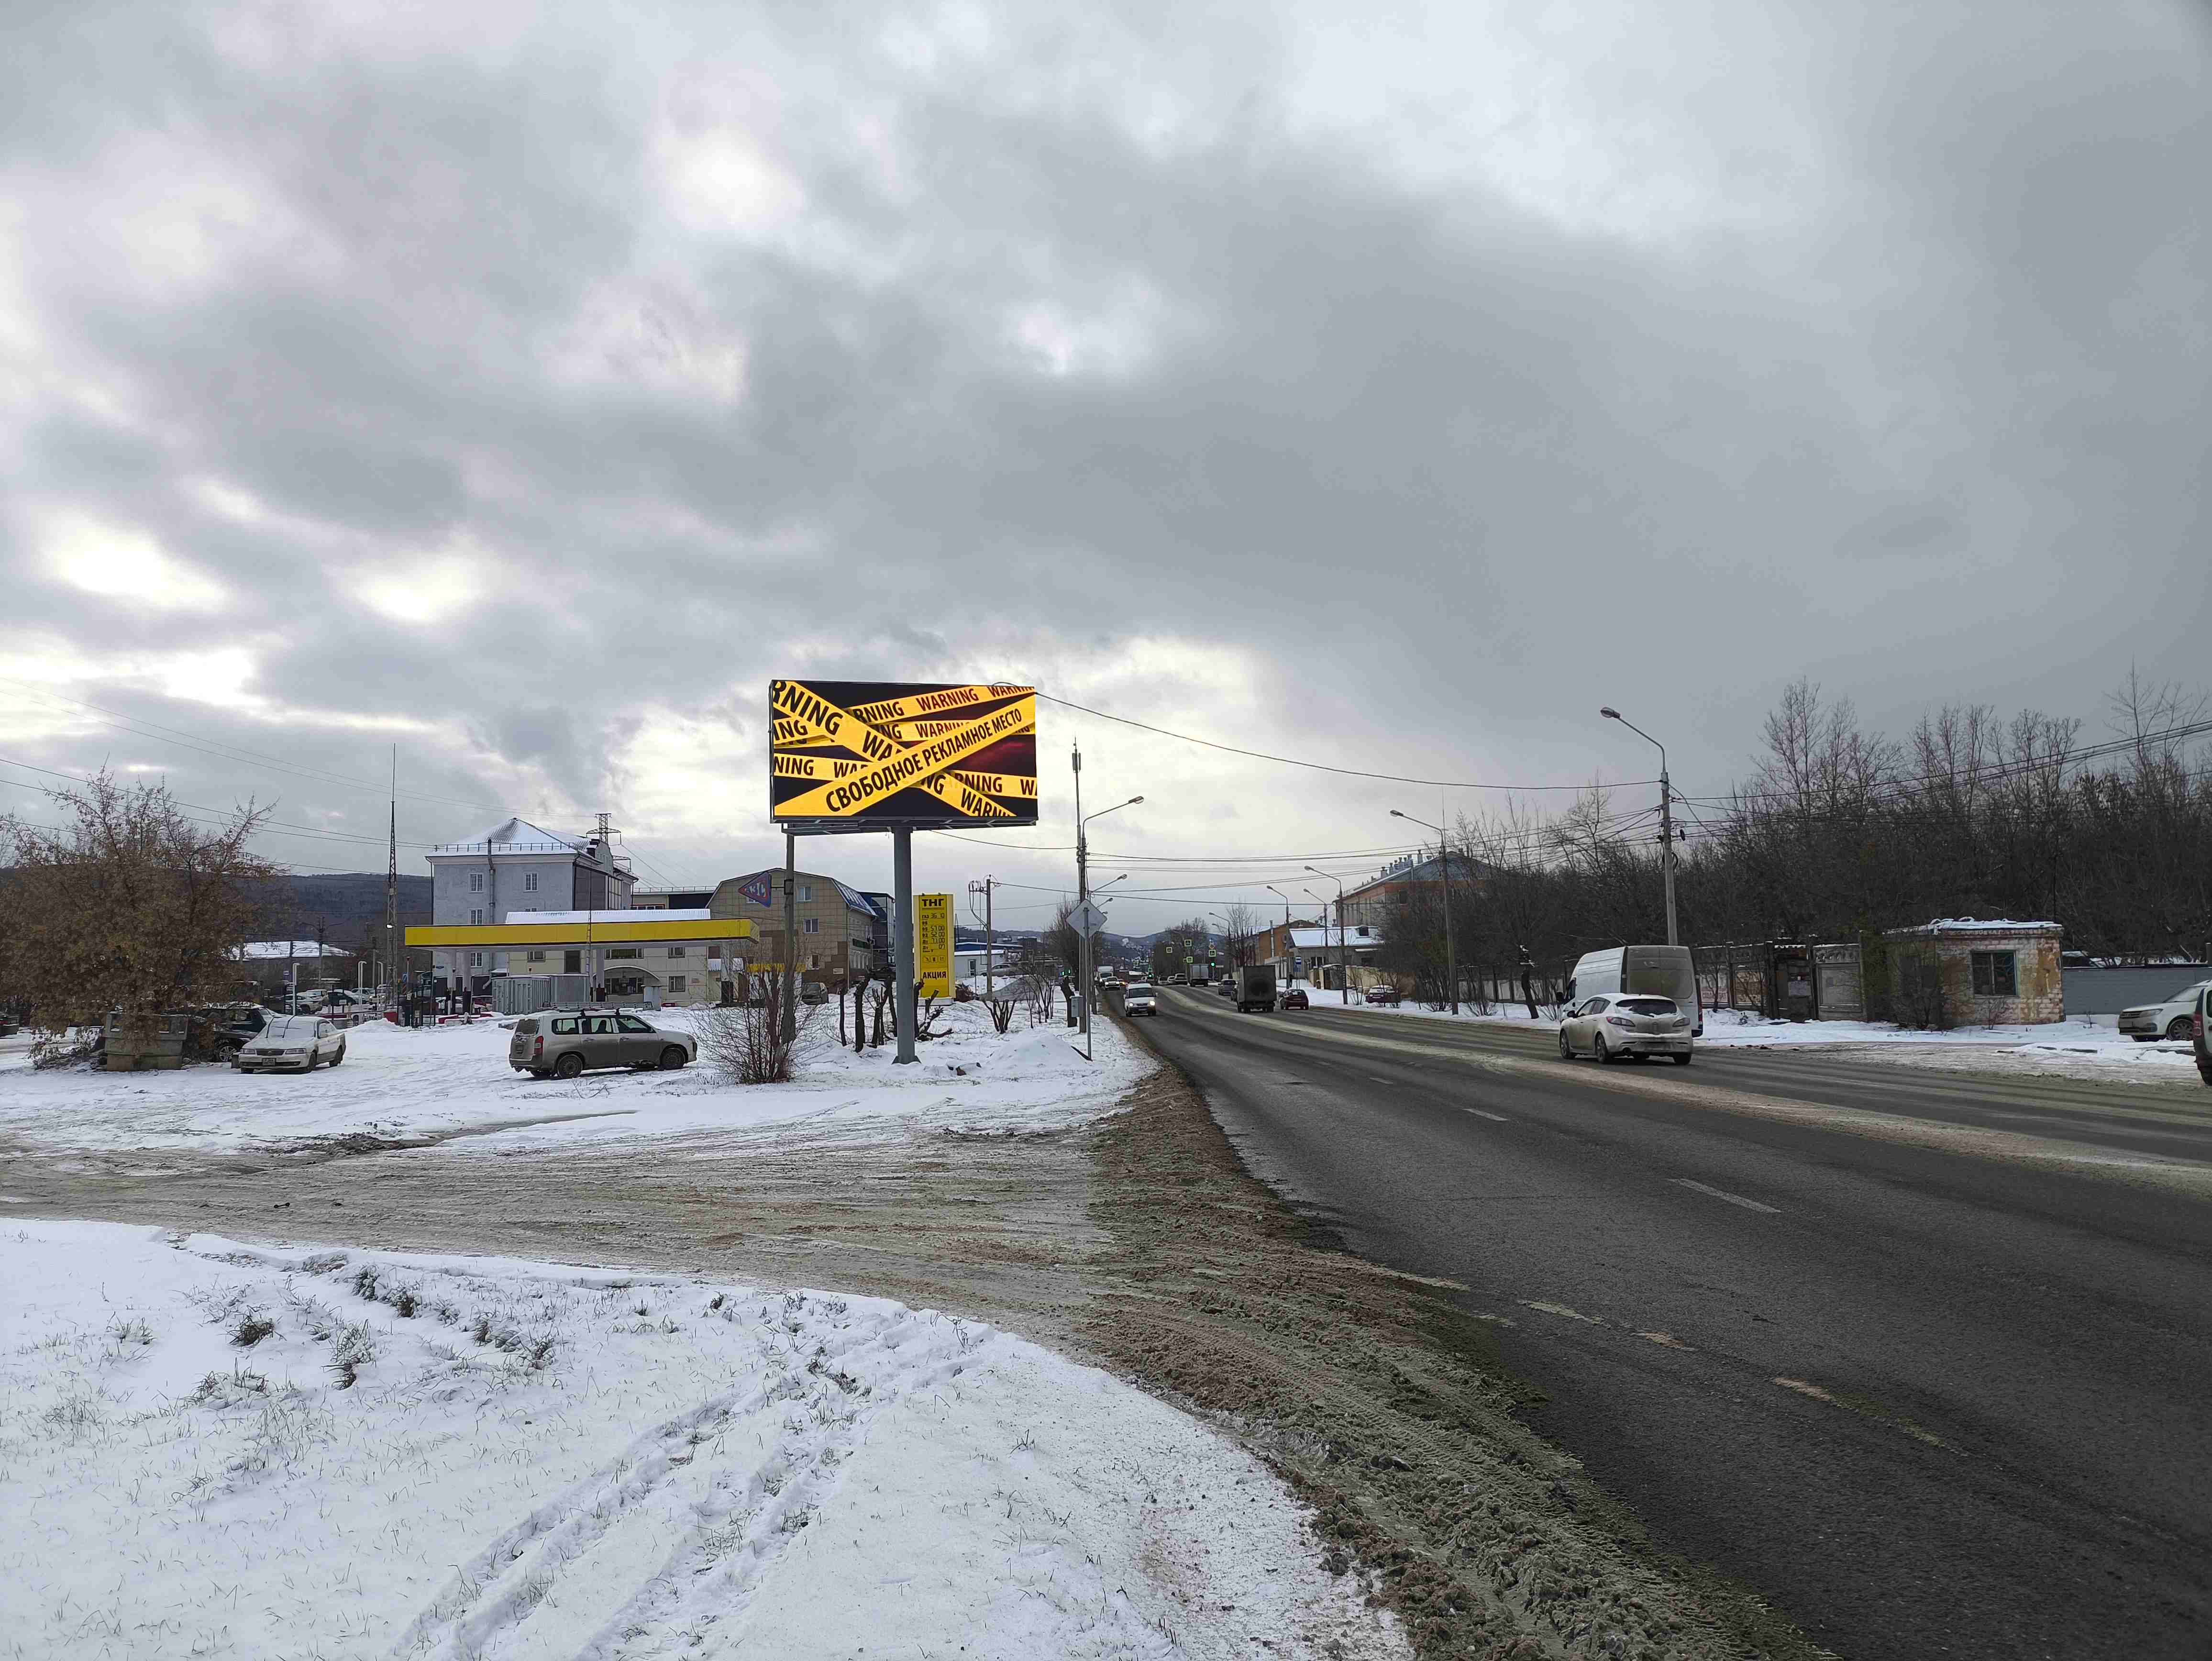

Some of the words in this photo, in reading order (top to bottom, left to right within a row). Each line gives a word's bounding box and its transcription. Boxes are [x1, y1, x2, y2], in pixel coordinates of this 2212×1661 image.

[916, 688, 979, 711] WARNING
[862, 730, 903, 761] WA
[826, 753, 920, 812] СВОБОДНОЕ
[922, 721, 993, 766] РЕКЛАМНОЕ
[991, 708, 1022, 734] МЕСТО
[921, 898, 944, 907] ТНГ
[922, 971, 946, 980] АКЦИЯ
